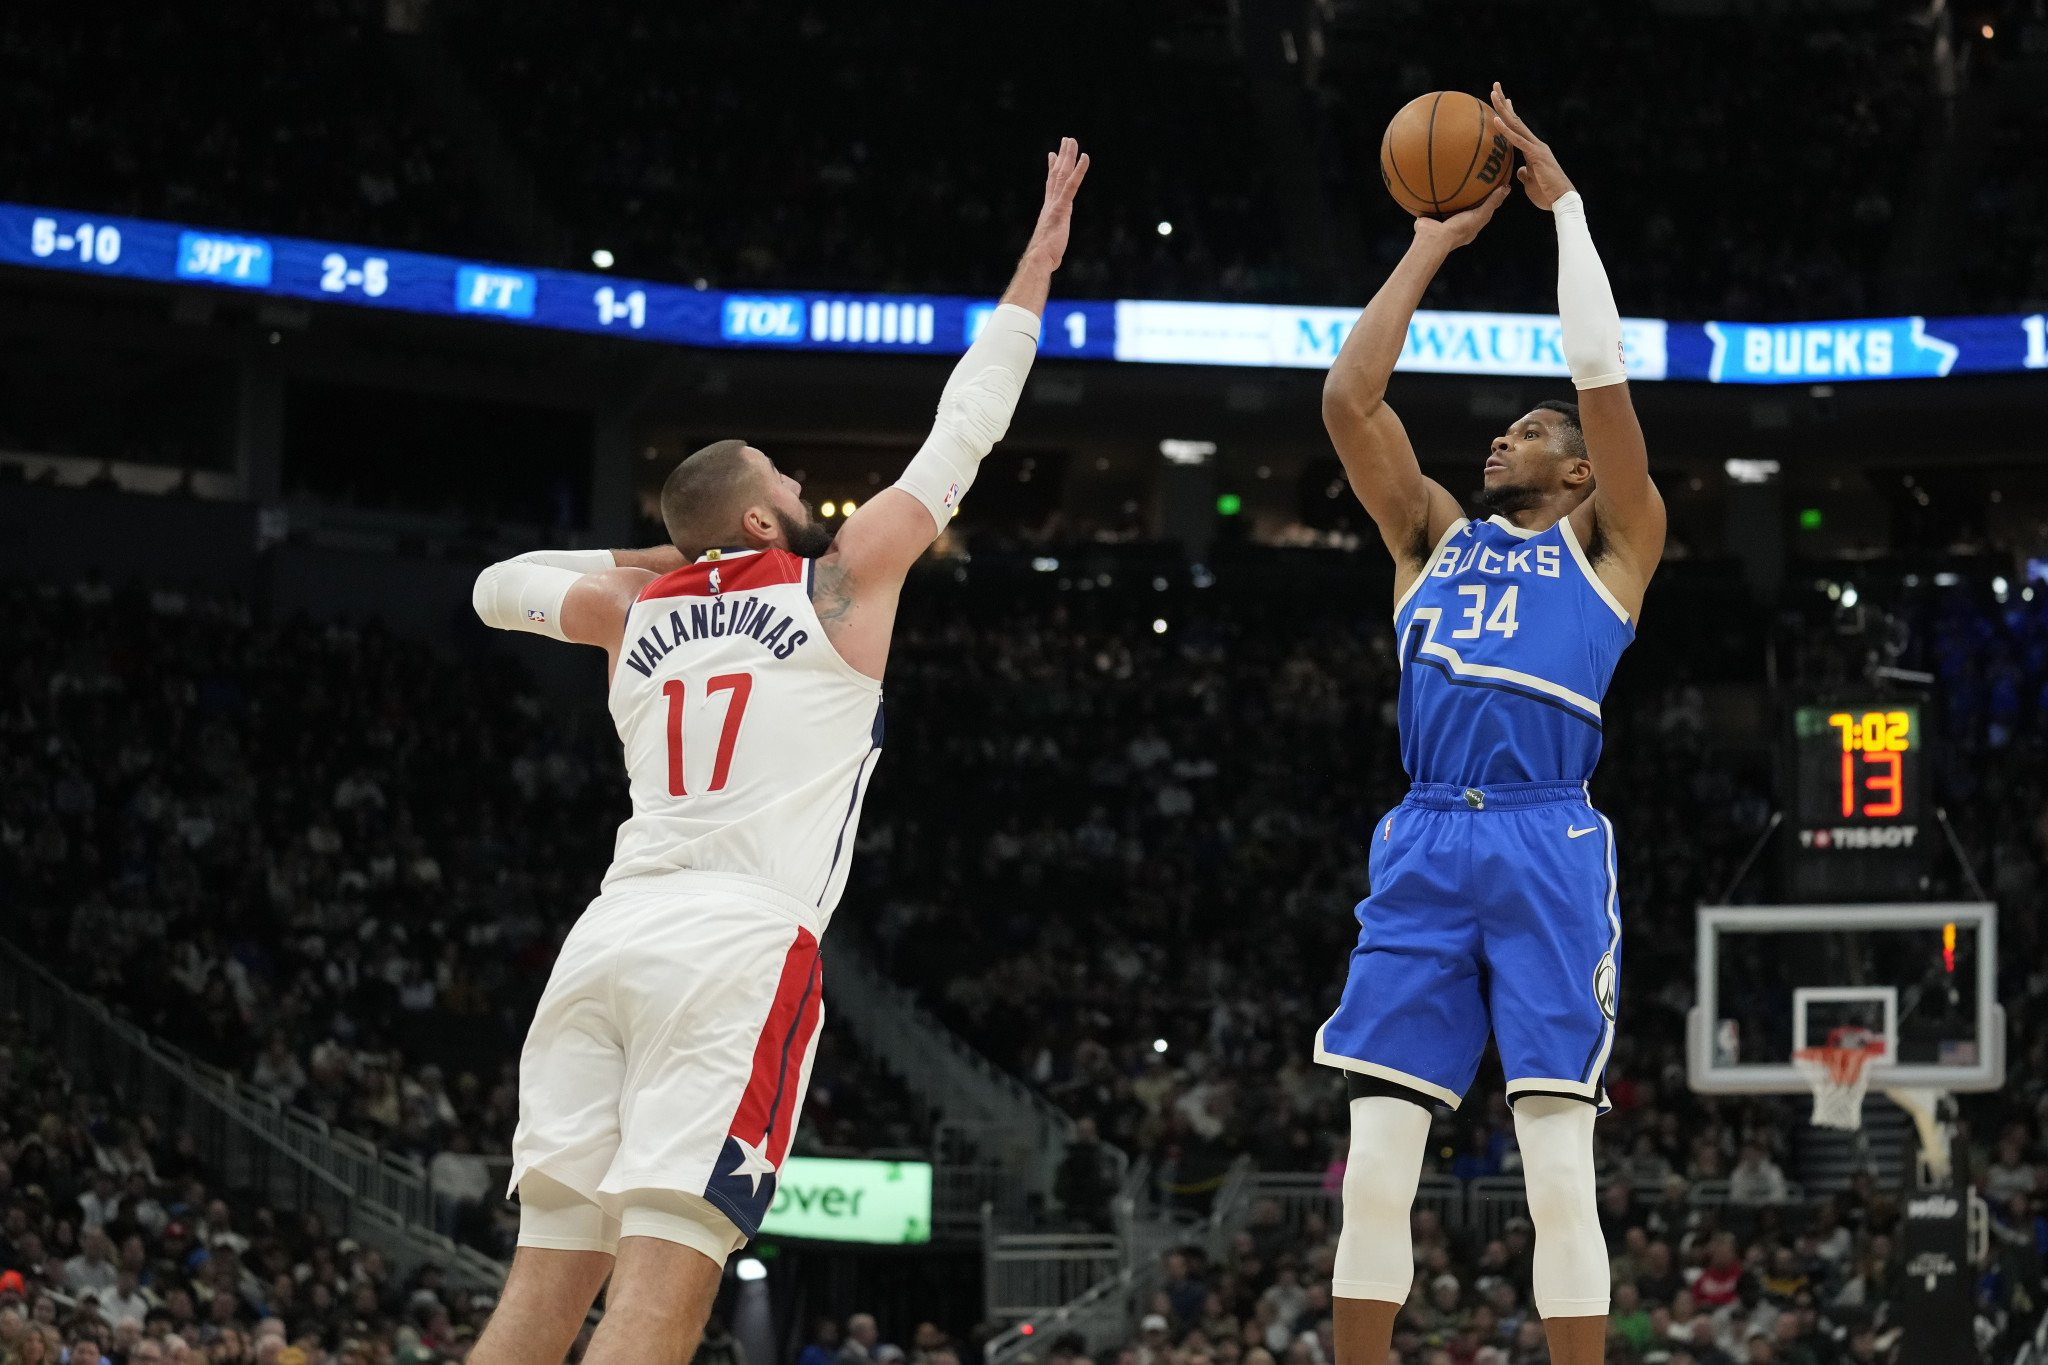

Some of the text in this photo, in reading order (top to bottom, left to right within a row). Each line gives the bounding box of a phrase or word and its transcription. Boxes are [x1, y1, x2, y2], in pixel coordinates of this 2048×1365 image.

[187, 238, 263, 278] 3PT
[320, 252, 389, 297] 2-5
[470, 273, 524, 309] FT
[594, 287, 647, 329] 1-1
[730, 302, 799, 336] TOL
[1064, 312, 1086, 348] 1
[1744, 328, 1893, 375] BUCKS
[1430, 541, 1560, 578] BUCKS
[1452, 585, 1519, 639] 34
[662, 672, 753, 797] 17
[1828, 711, 1910, 752] 7:02
[1841, 751, 1903, 818] 13
